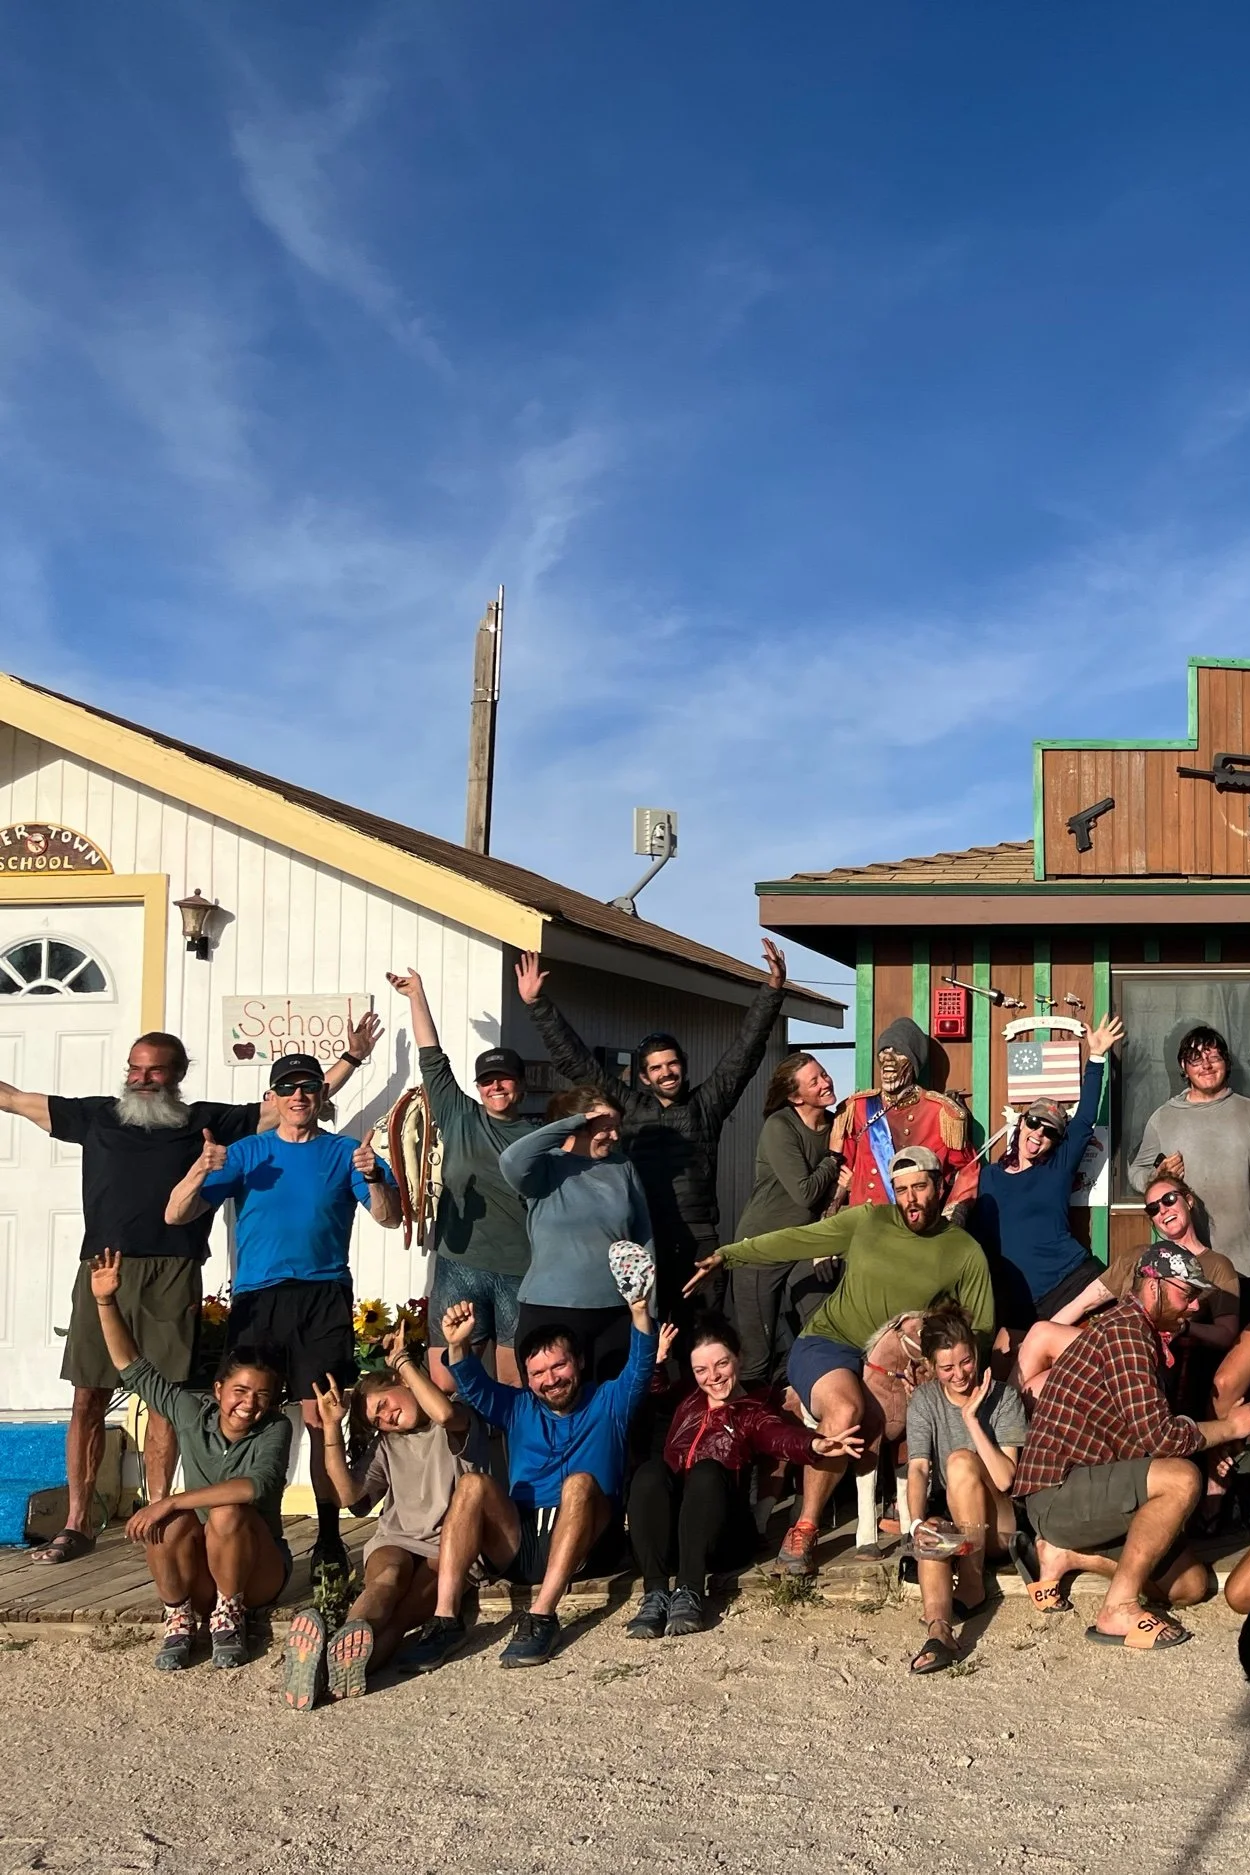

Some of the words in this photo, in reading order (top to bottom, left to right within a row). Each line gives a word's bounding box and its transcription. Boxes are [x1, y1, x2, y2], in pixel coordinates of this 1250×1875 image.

[0, 824, 29, 848] ER
[47, 825, 101, 865] TOWN
[238, 998, 352, 1037] School
